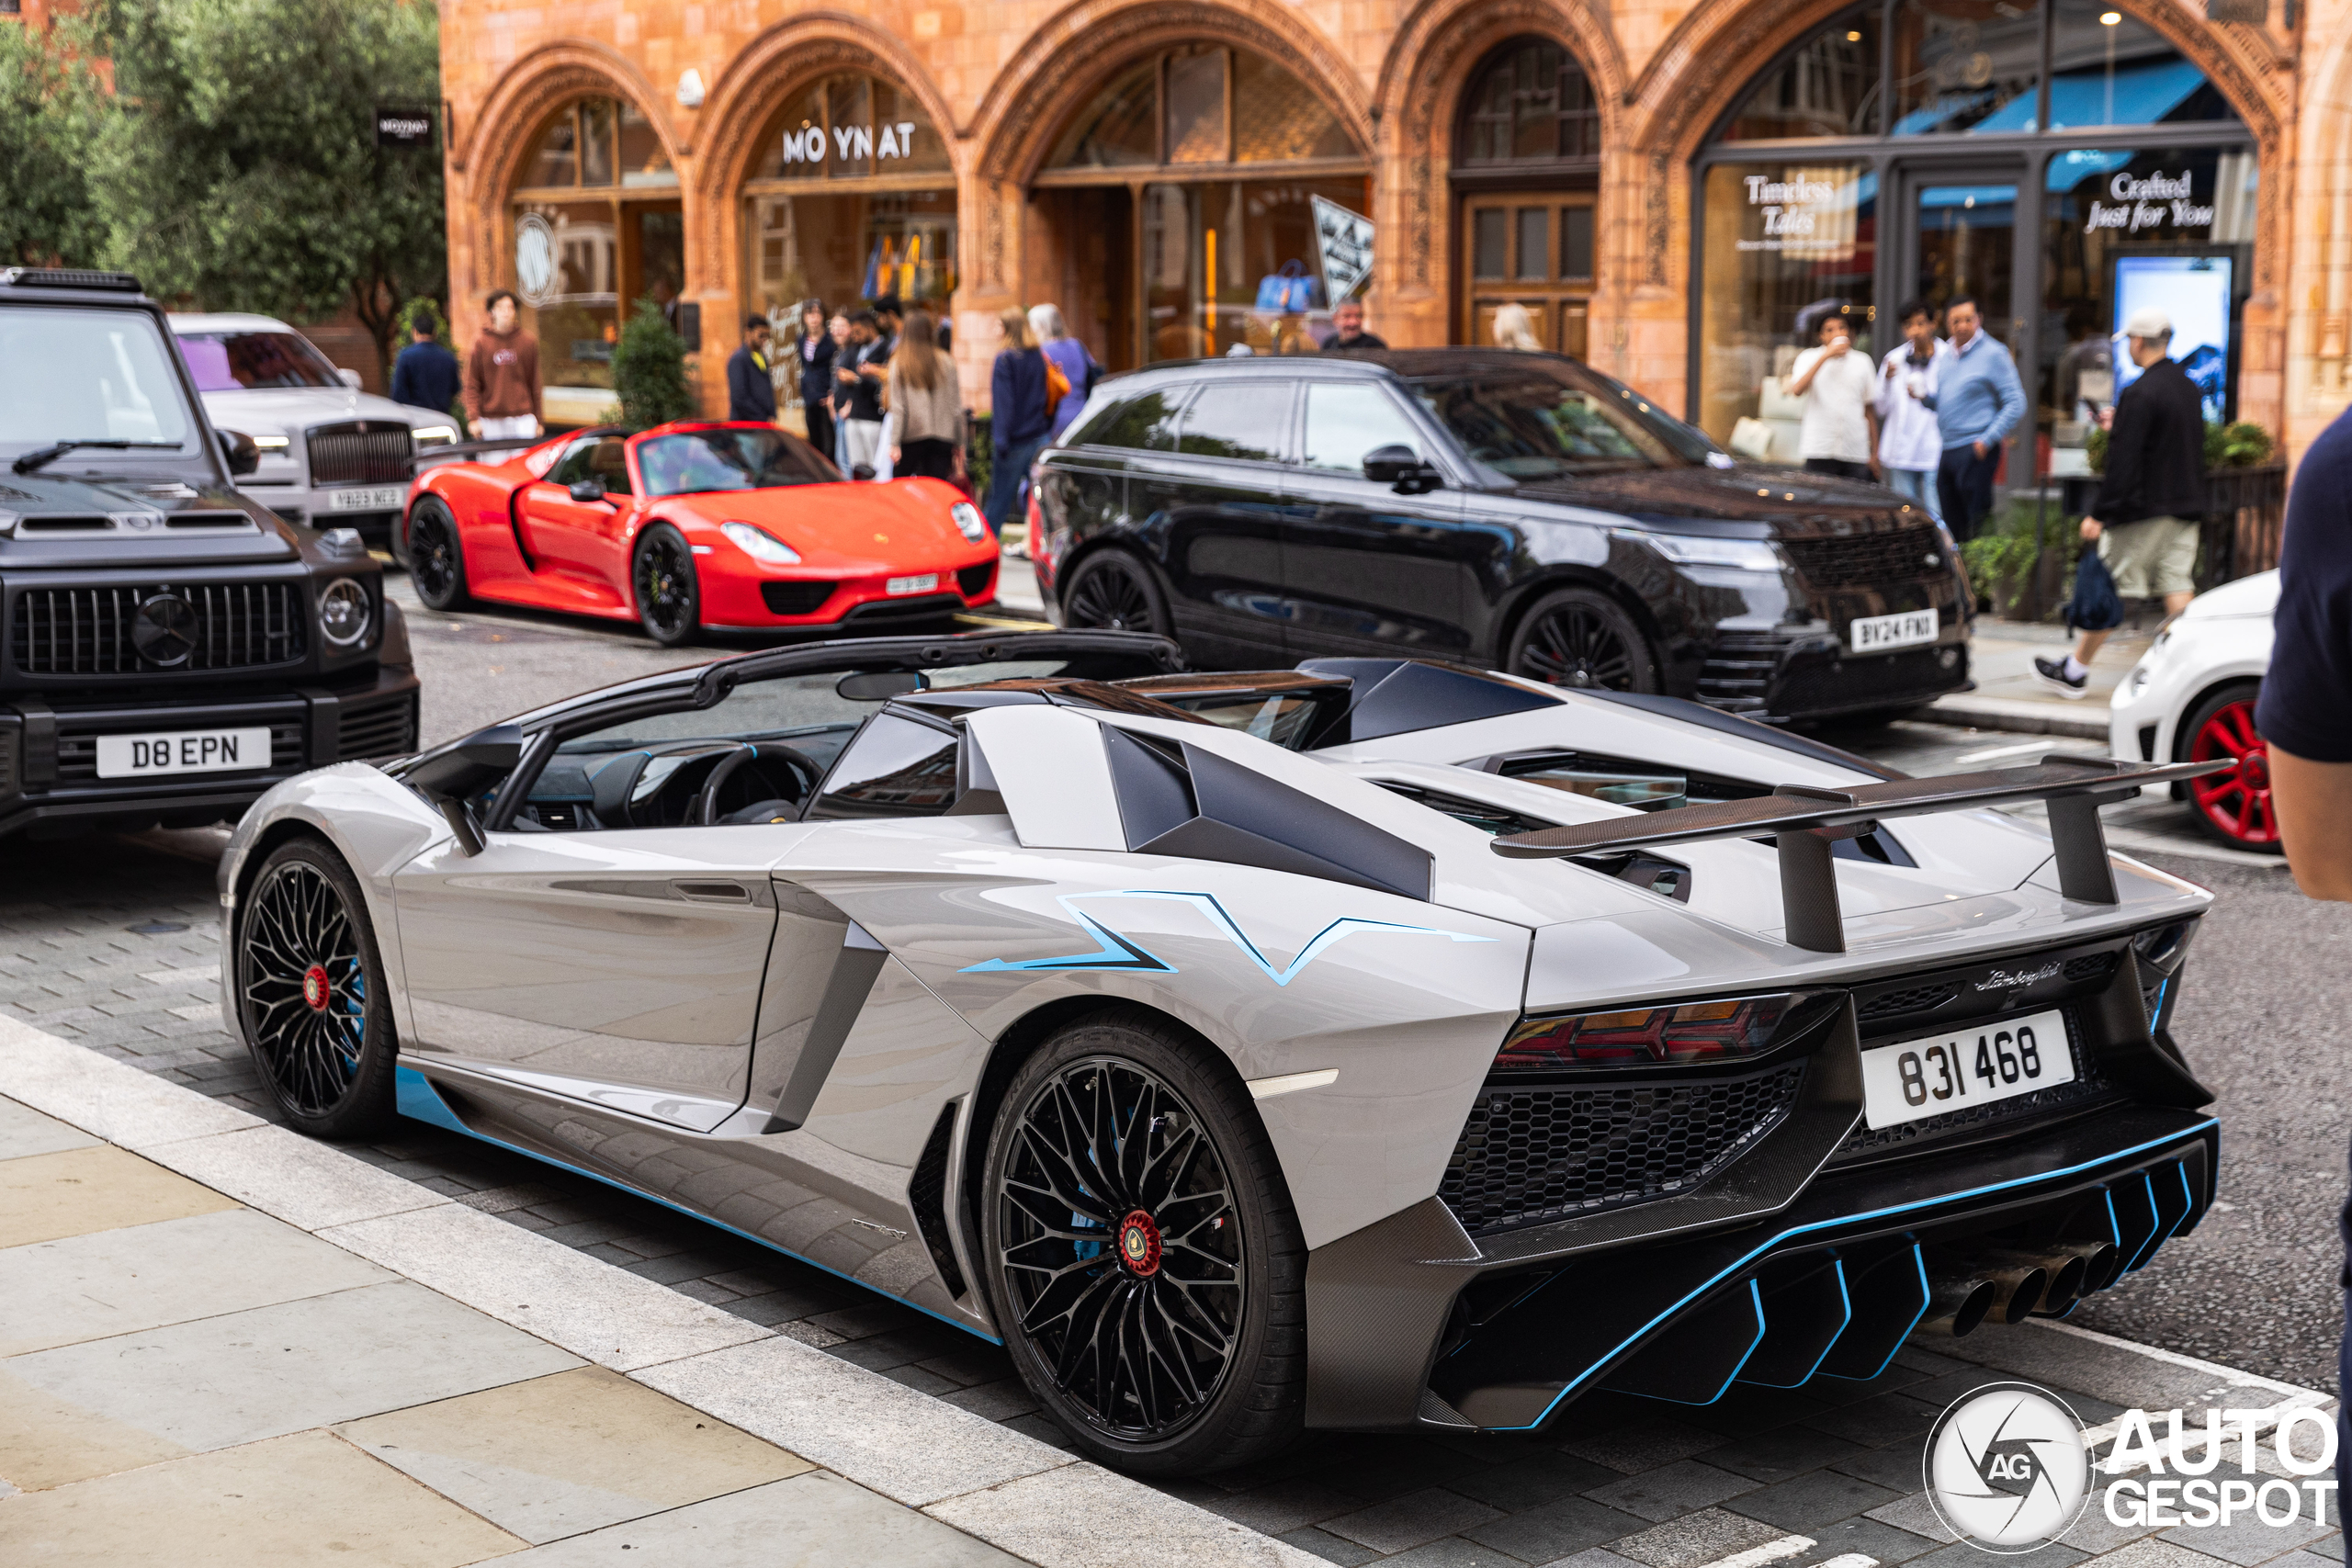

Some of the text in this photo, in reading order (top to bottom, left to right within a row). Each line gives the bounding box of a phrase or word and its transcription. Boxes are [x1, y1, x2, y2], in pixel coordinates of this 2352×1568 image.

[783, 122, 916, 164] MOYNAT
[1744, 174, 1834, 205] Timeless
[2110, 169, 2192, 201] Crafted
[2084, 197, 2215, 234] Just for You
[131, 735, 238, 769] D8 EPN
[1897, 1026, 2041, 1107] 831 468
